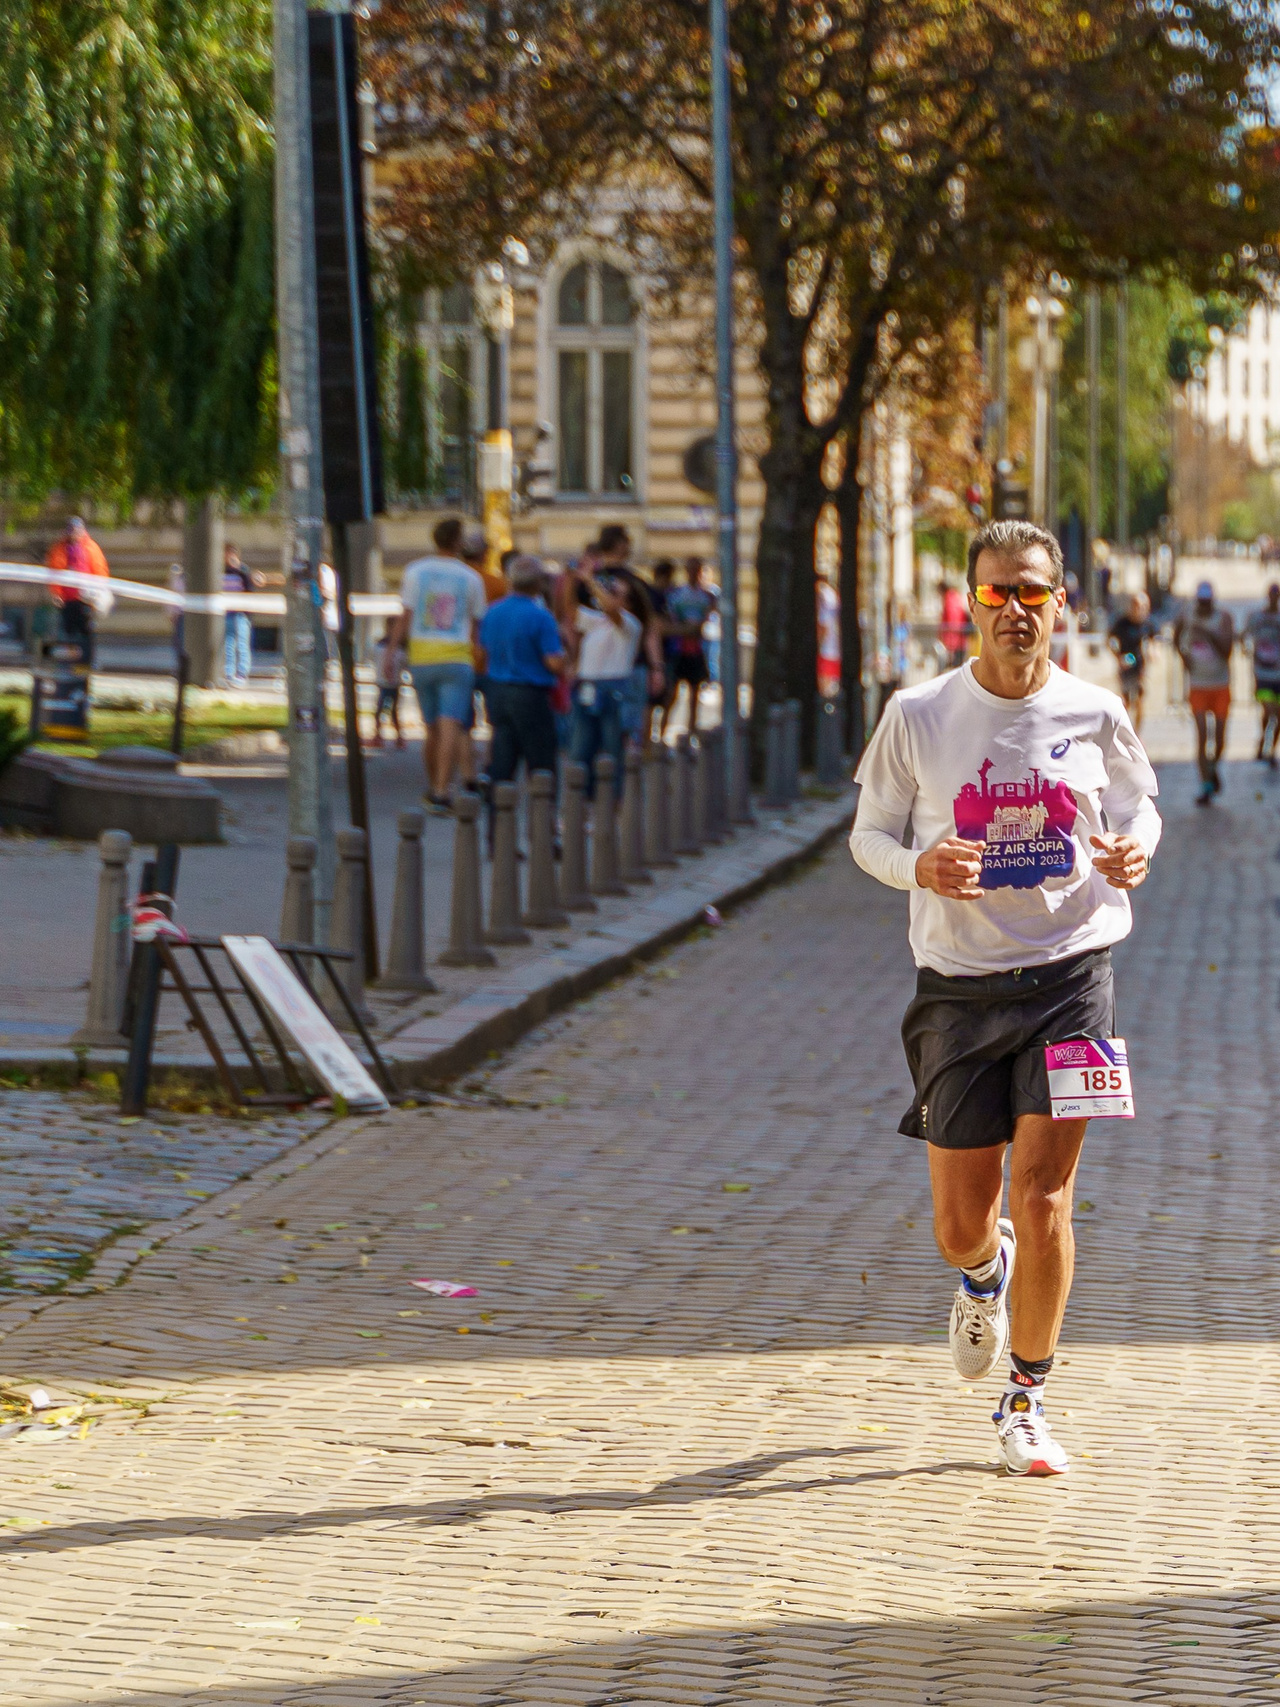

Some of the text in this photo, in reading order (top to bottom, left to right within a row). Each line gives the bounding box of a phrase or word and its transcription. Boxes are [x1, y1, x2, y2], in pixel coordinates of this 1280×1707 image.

[1004, 843, 1026, 855] AIR
[1029, 840, 1065, 853] SOFIA
[1040, 854, 1066, 866] 2023
[1080, 1070, 1122, 1091] 185
